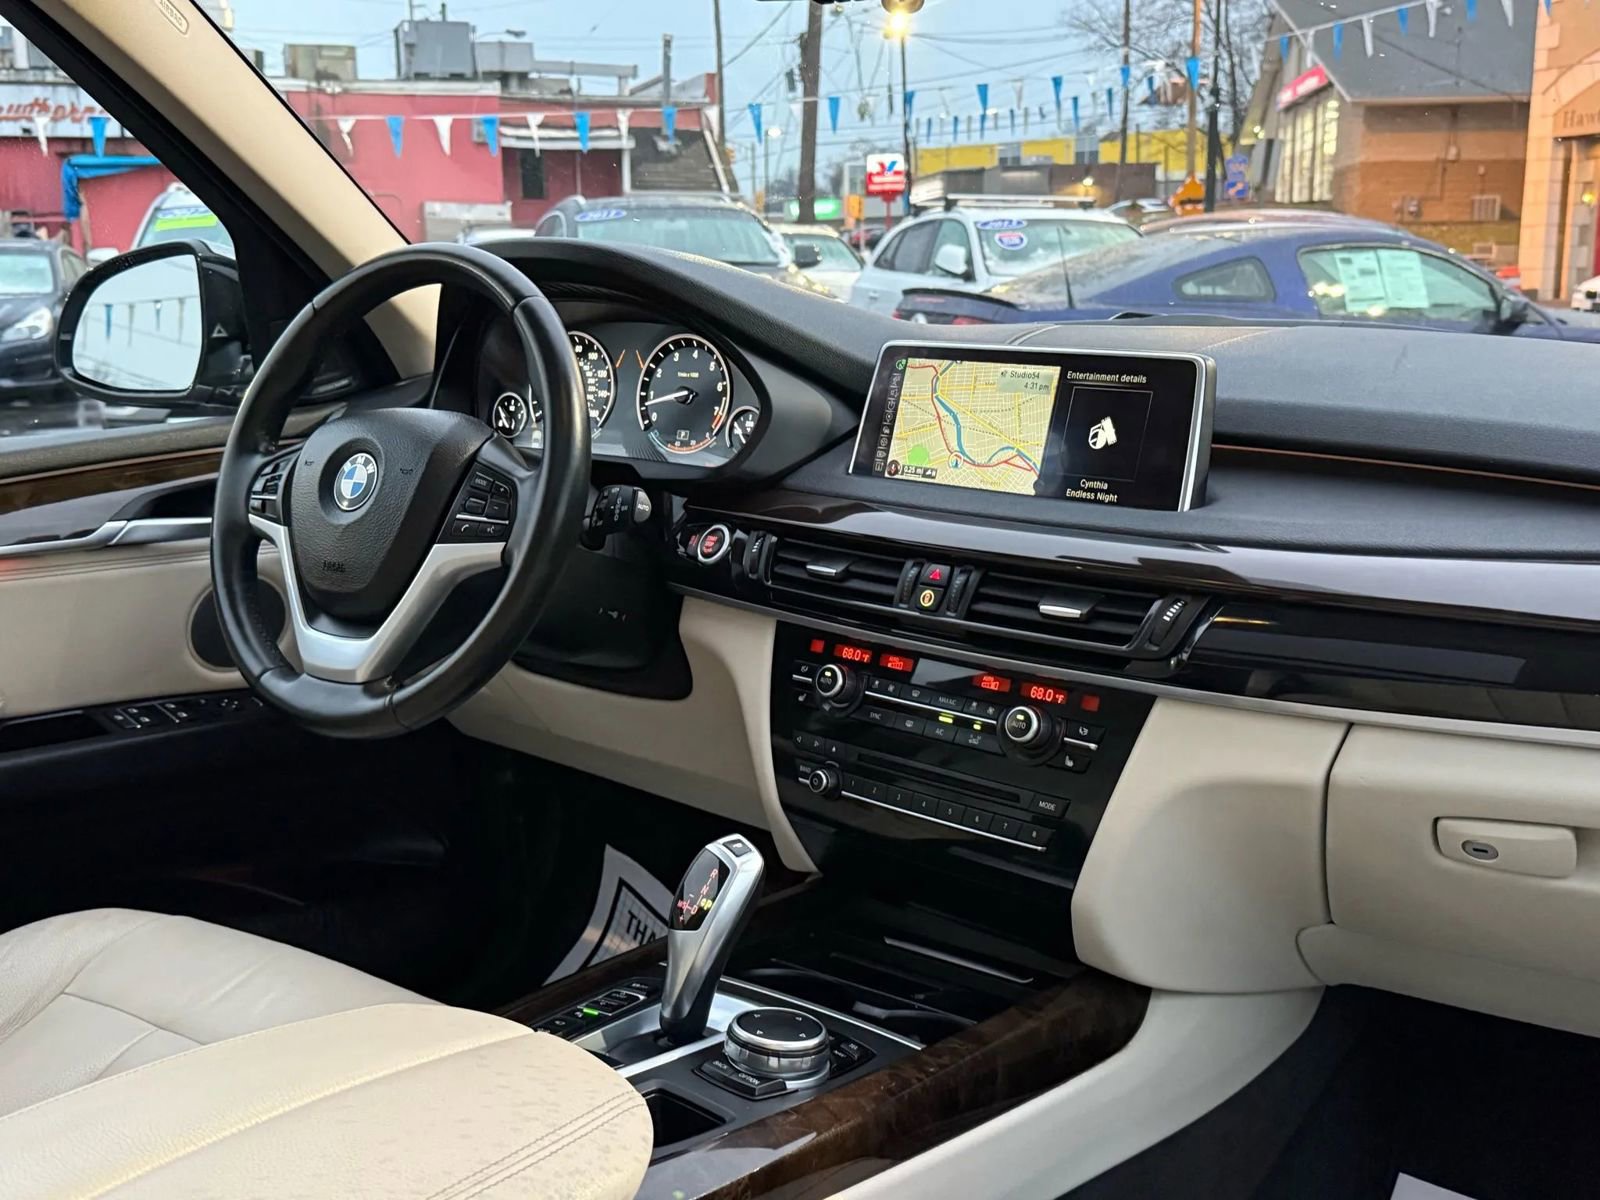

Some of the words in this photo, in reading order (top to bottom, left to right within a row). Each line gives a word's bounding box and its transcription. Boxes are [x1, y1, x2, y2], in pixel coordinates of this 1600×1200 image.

[674, 352, 679, 361] 3
[693, 350, 698, 359] 4
[710, 362, 715, 371] 5
[656, 369, 662, 378] 2
[1009, 370, 1041, 380] Studio54
[1066, 371, 1119, 382] Entertainment
[1120, 374, 1147, 384] details
[717, 382, 722, 391] 6
[1038, 384, 1050, 392] pm
[650, 391, 654, 399] 1
[714, 406, 719, 415] 7
[652, 412, 657, 421] 0
[343, 455, 375, 475] BMW
[1080, 479, 1108, 490] Cynthia
[1066, 488, 1095, 500] Endless
[1096, 491, 1118, 503] Night
[842, 647, 861, 661] 68.0
[1030, 686, 1053, 702] 68.0
[1038, 801, 1057, 811] MODE
[710, 868, 719, 879] R
[701, 884, 709, 896] N
[691, 904, 698, 915] D
[738, 1071, 760, 1085] OPTION
